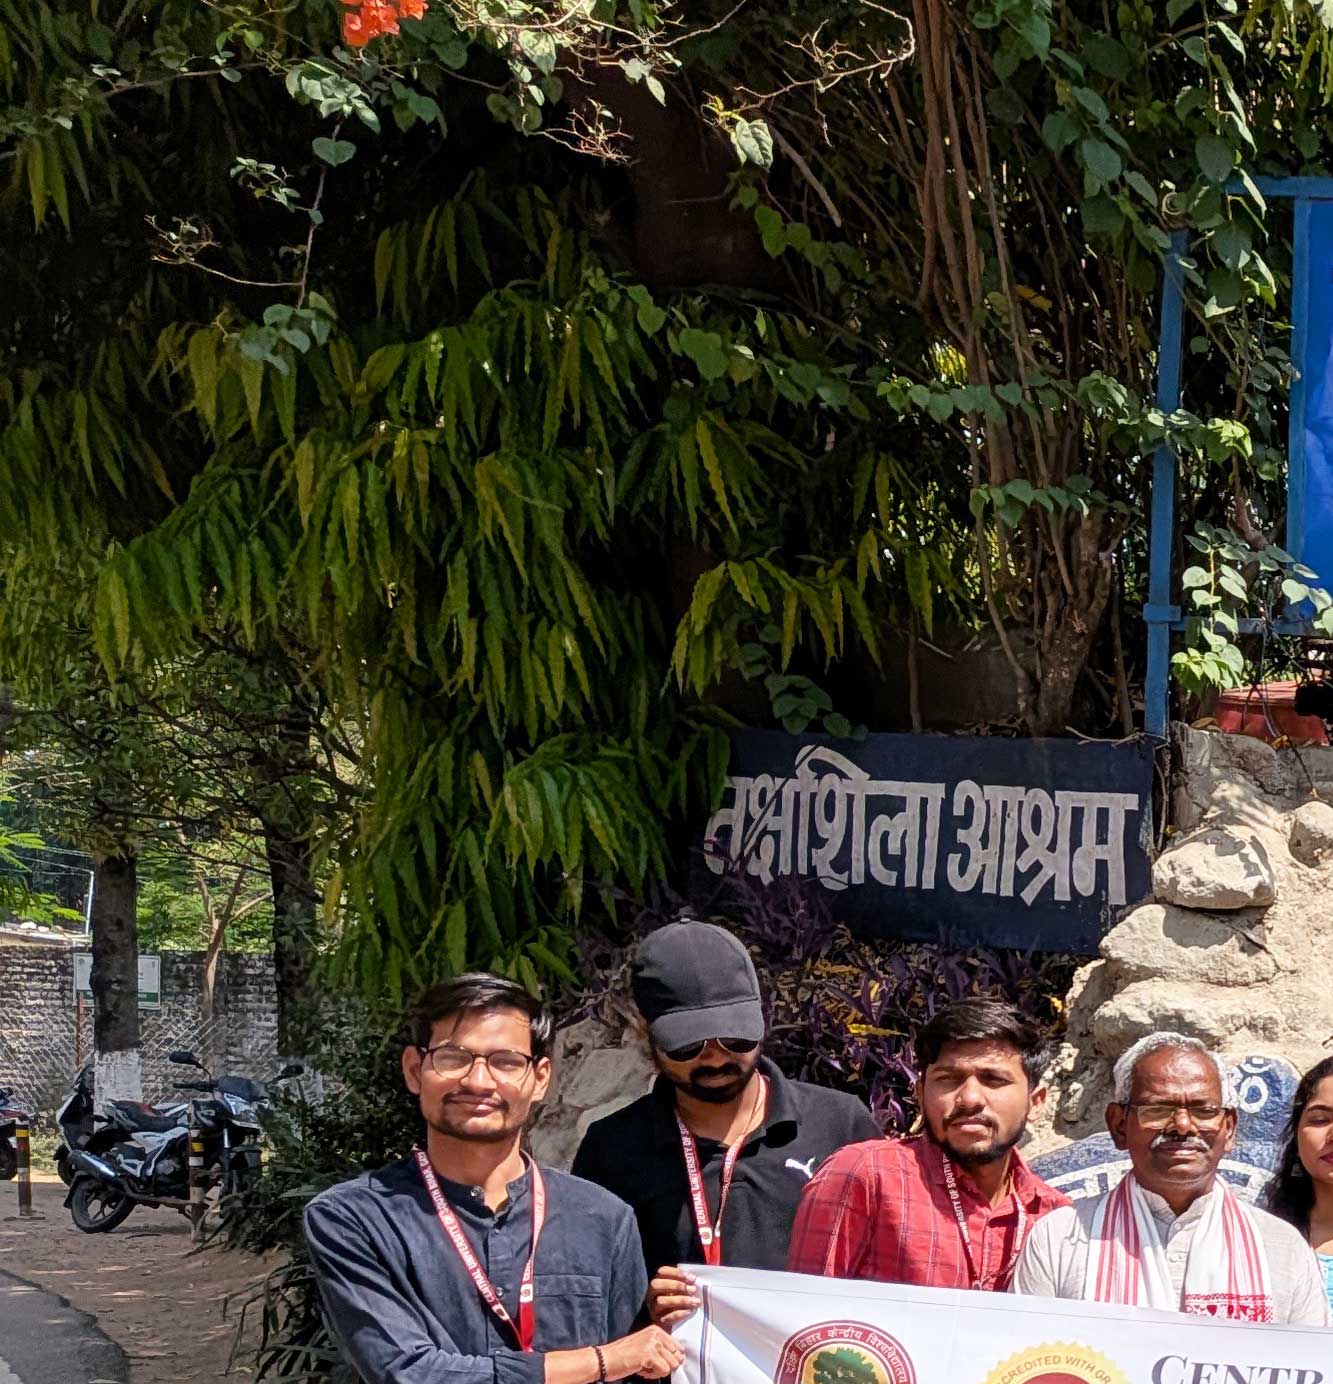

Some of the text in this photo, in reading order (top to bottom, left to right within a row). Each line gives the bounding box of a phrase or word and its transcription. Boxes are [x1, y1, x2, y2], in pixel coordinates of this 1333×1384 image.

[704, 744, 1139, 906] तक्षशिला आश्रम
[428, 1188, 449, 1217] SOUTH
[444, 1223, 480, 1271] UNIVERSITY
[469, 1268, 498, 1304] CENTRAL
[1065, 1355, 1096, 1373] WITH
